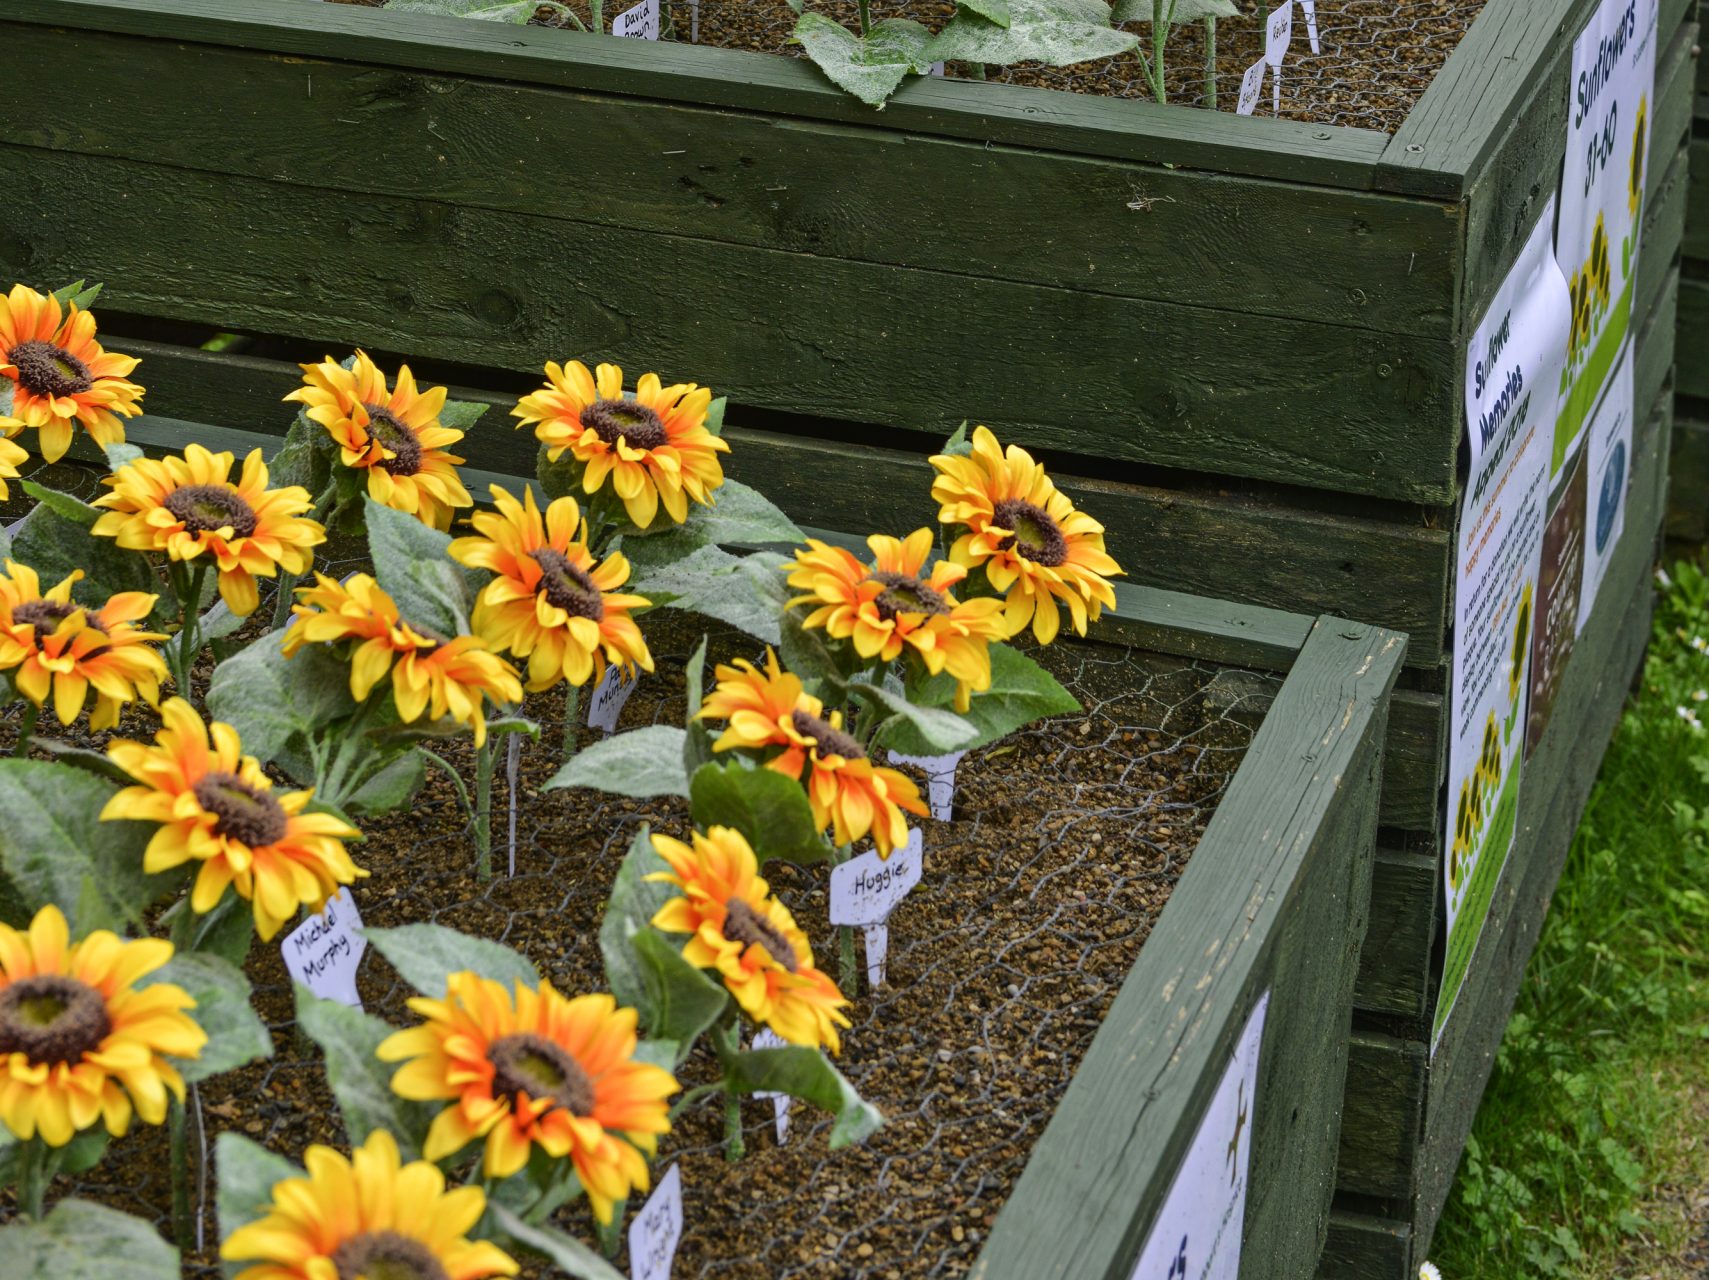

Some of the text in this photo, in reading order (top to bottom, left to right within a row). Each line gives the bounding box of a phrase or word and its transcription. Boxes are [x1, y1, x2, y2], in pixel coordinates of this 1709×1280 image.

[624, 1, 650, 29] David
[1584, 99, 1617, 199] 31-60
[1475, 308, 1511, 400] Sunflower
[1479, 364, 1523, 457] Memories
[855, 862, 904, 895] Huggie
[294, 902, 338, 956] Michael
[303, 934, 351, 985] Murphy
